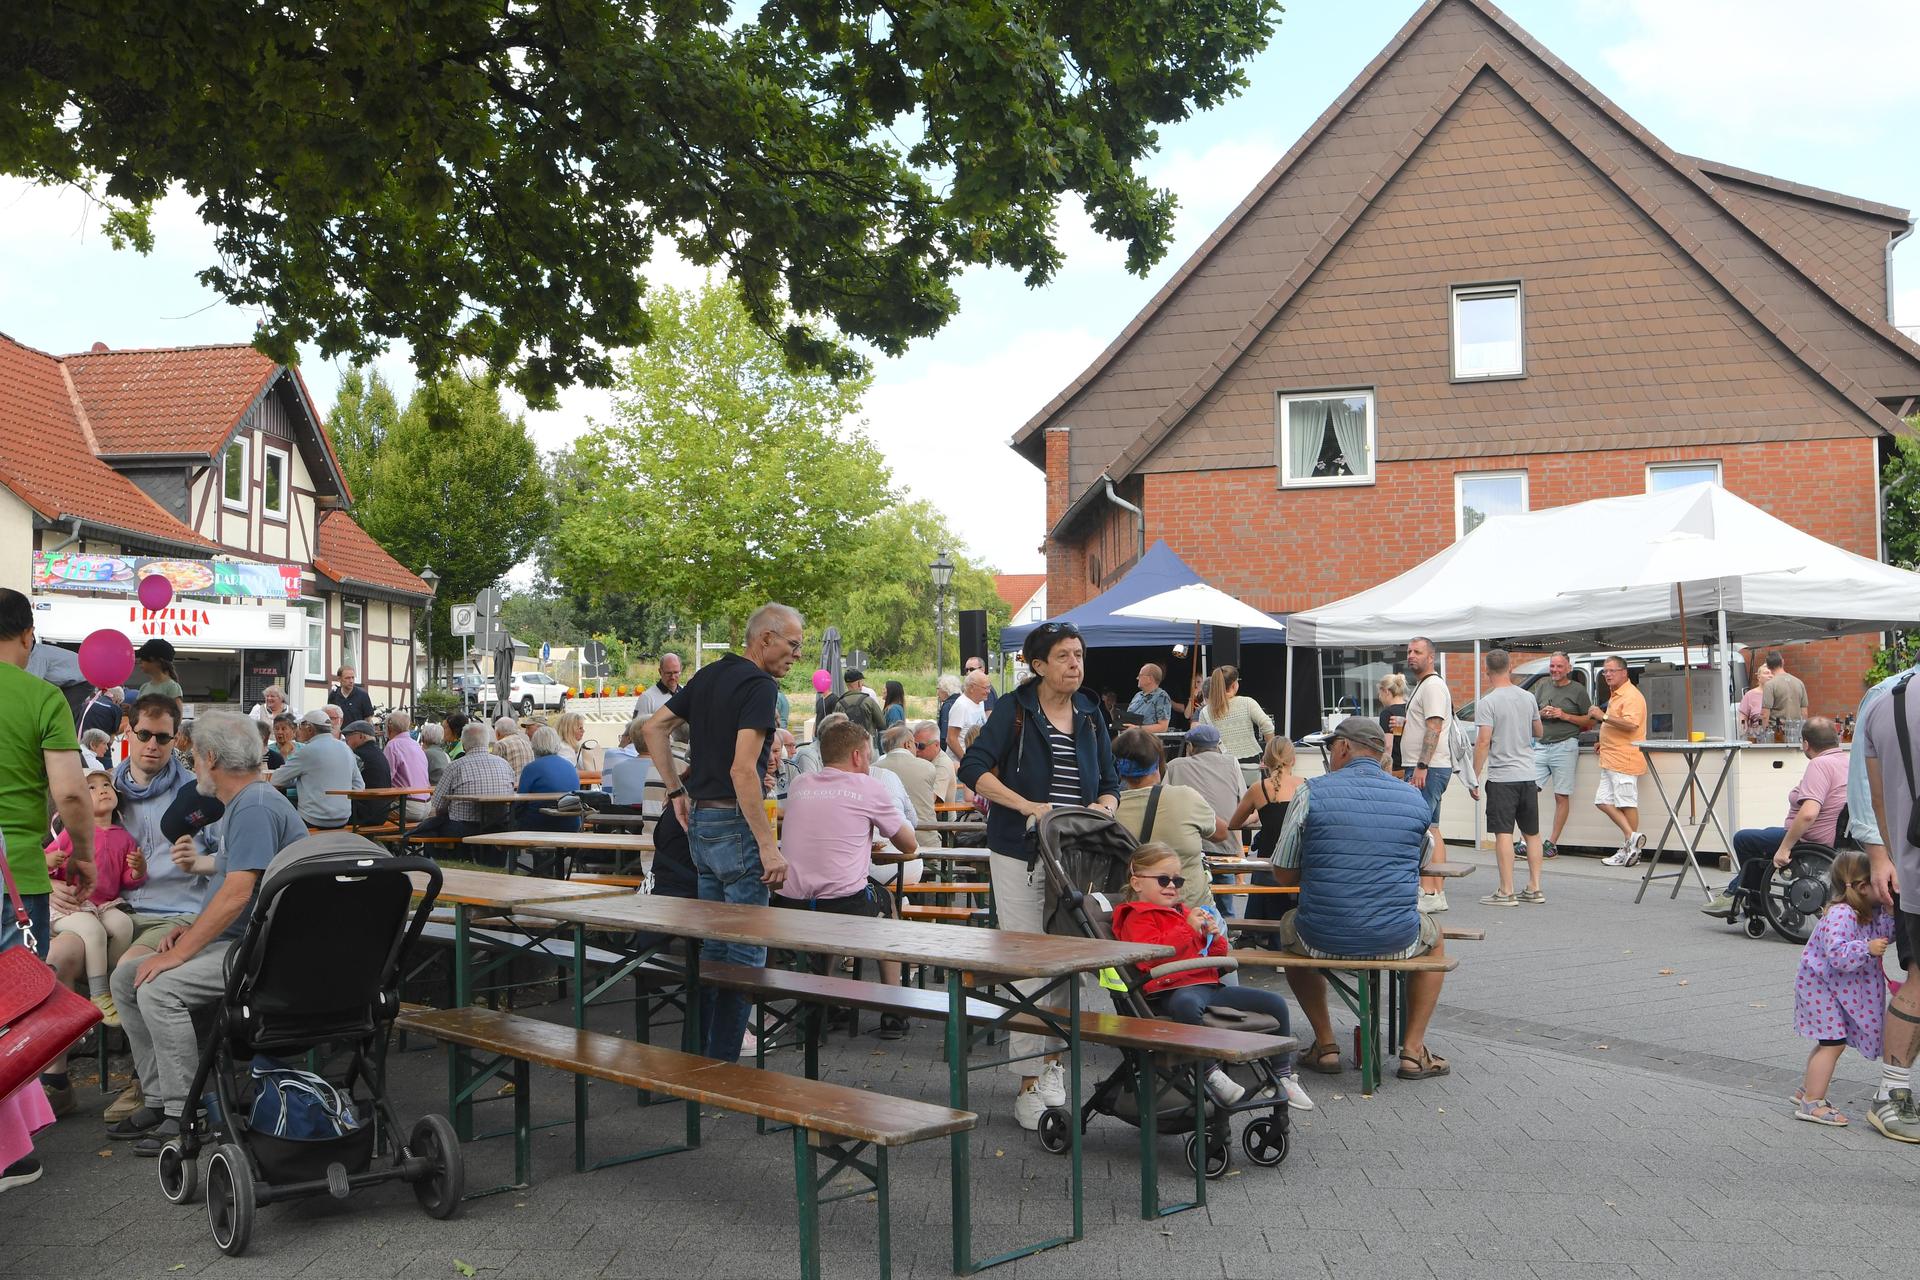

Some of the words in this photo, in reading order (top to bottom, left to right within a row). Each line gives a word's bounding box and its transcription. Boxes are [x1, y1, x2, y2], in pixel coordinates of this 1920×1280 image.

[43, 552, 114, 582] Tina
[130, 607, 210, 625] PIZZERIA
[252, 667, 277, 675] PIZZA
